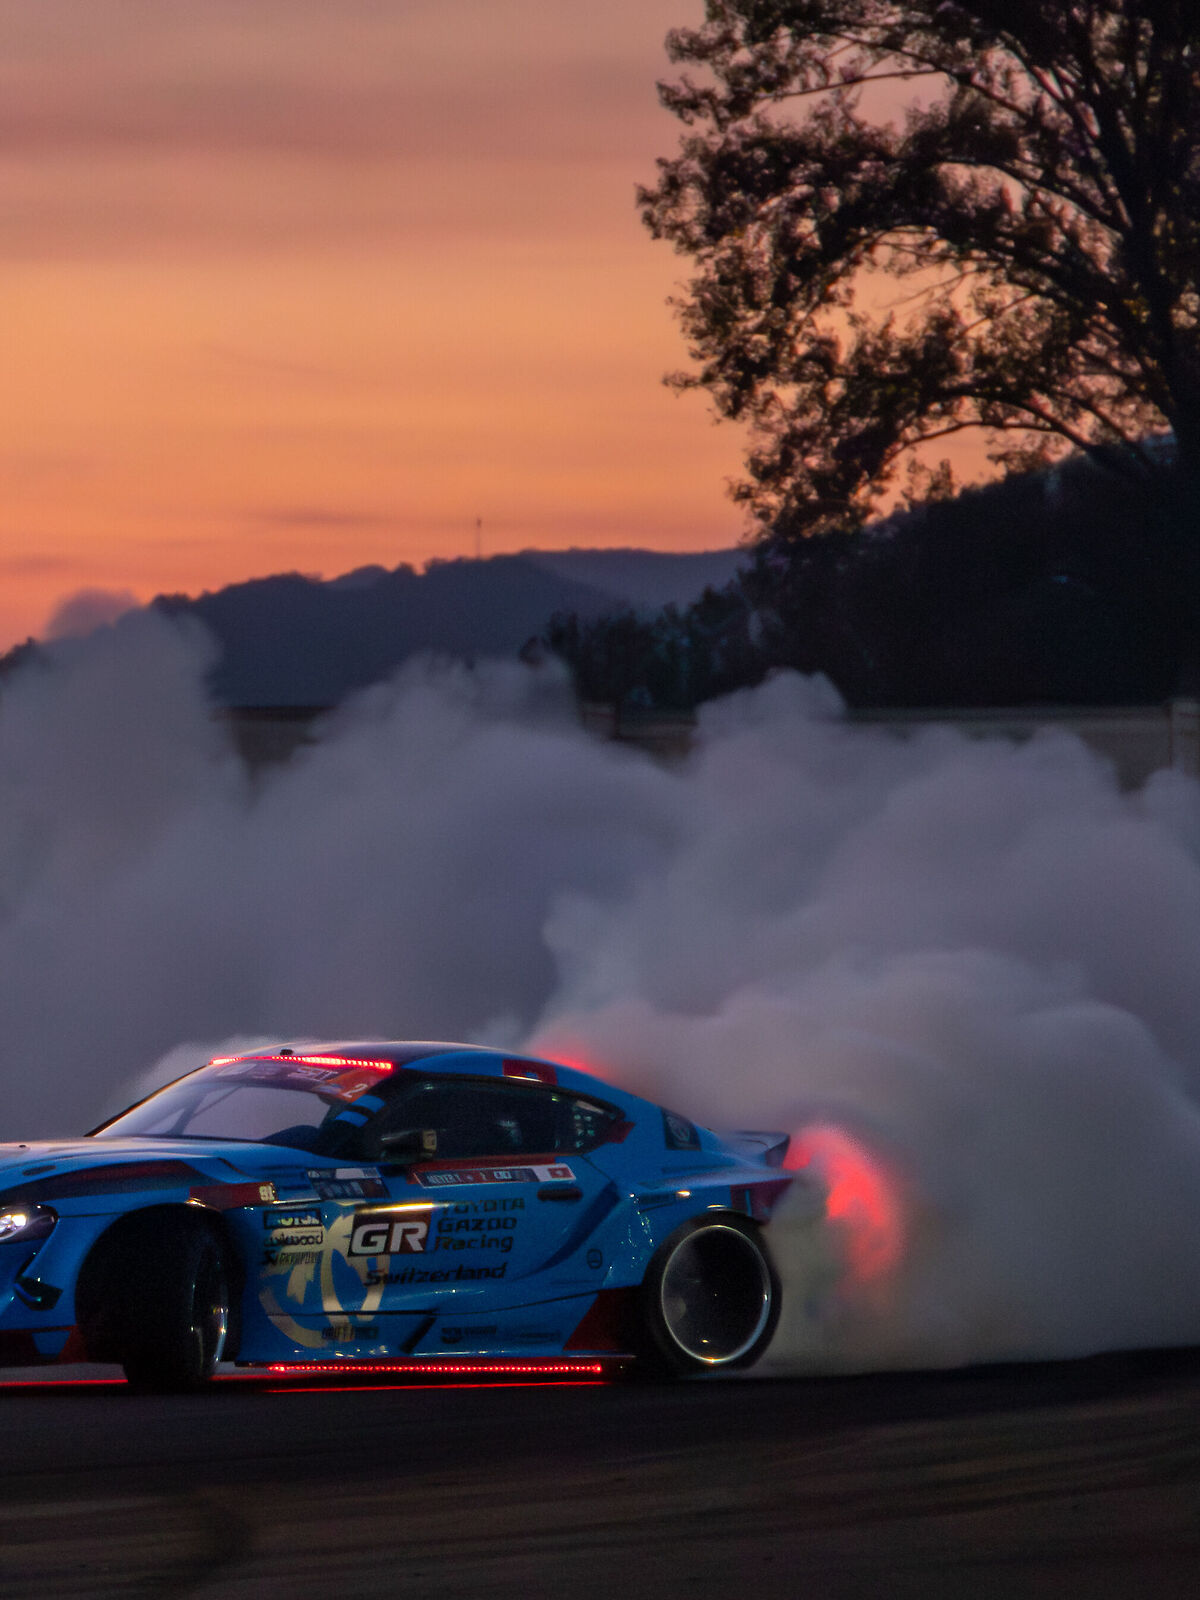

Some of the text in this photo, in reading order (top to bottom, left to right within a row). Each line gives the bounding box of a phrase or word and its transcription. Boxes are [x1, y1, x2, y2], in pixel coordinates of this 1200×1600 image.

[438, 1198, 525, 1216] TOYOTA
[438, 1217, 517, 1233] GAZOO
[351, 1221, 428, 1254] GR
[435, 1234, 514, 1253] Racing
[364, 1262, 509, 1286] Switzerland
